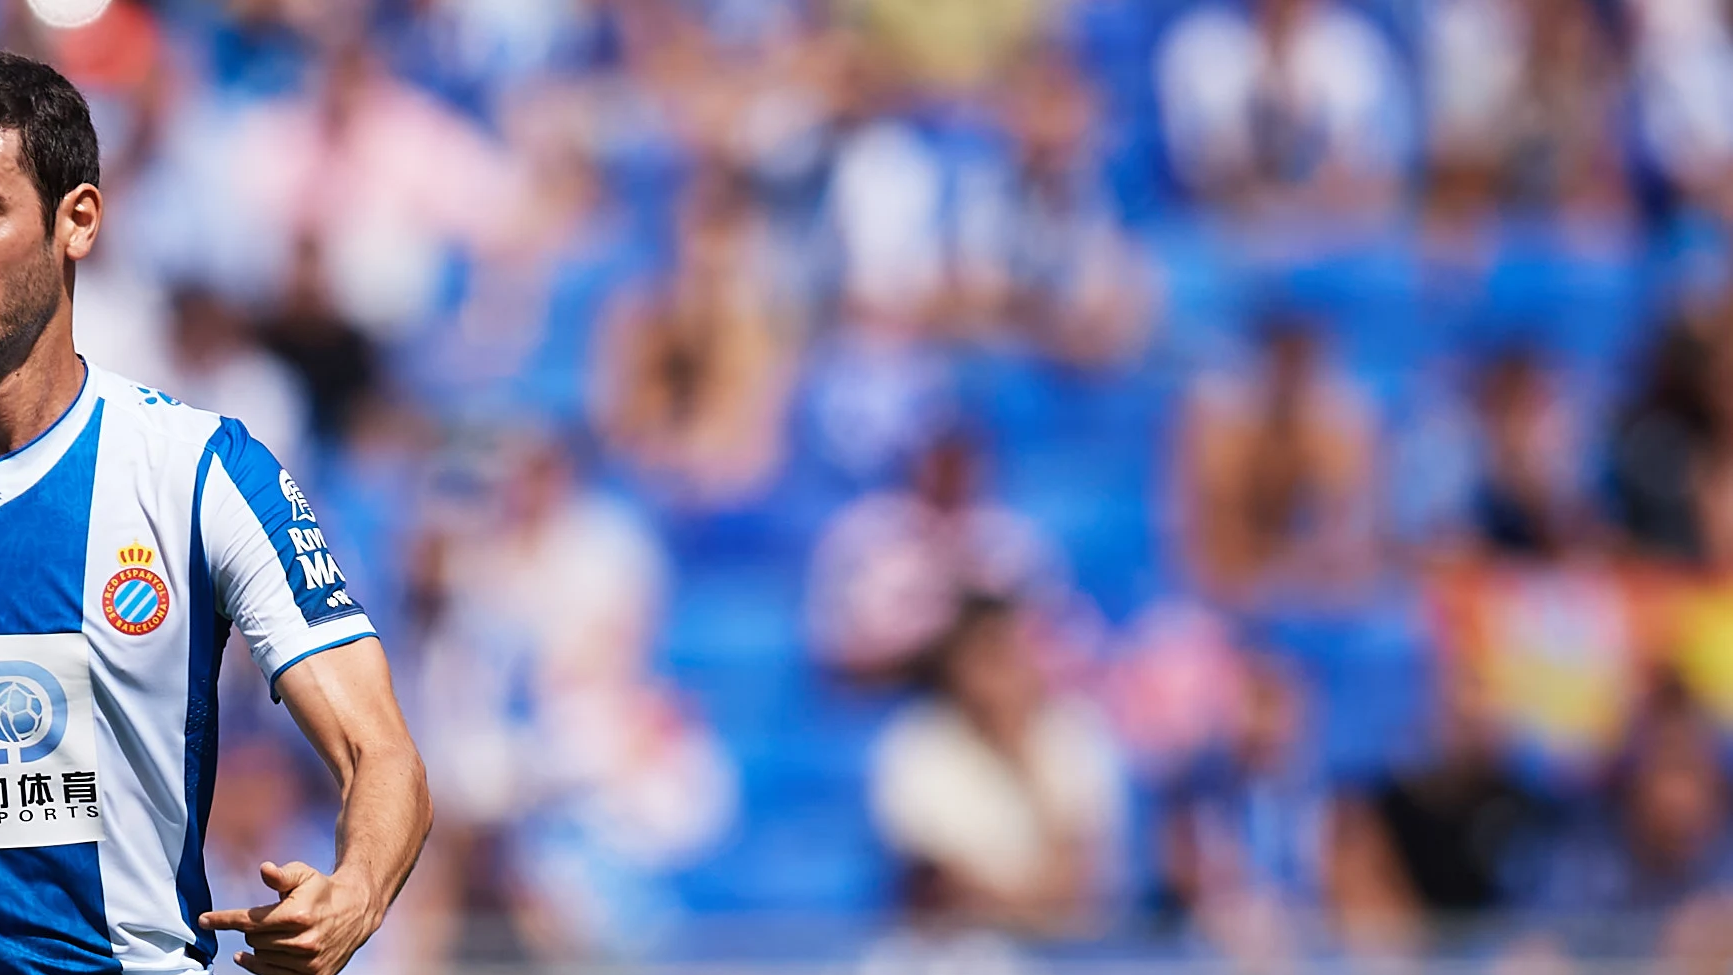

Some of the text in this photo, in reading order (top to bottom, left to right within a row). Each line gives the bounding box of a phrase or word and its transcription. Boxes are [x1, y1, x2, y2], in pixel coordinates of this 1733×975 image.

[104, 569, 167, 599] RCD ESPANYOL
[105, 603, 168, 633] DE BARCELONA
